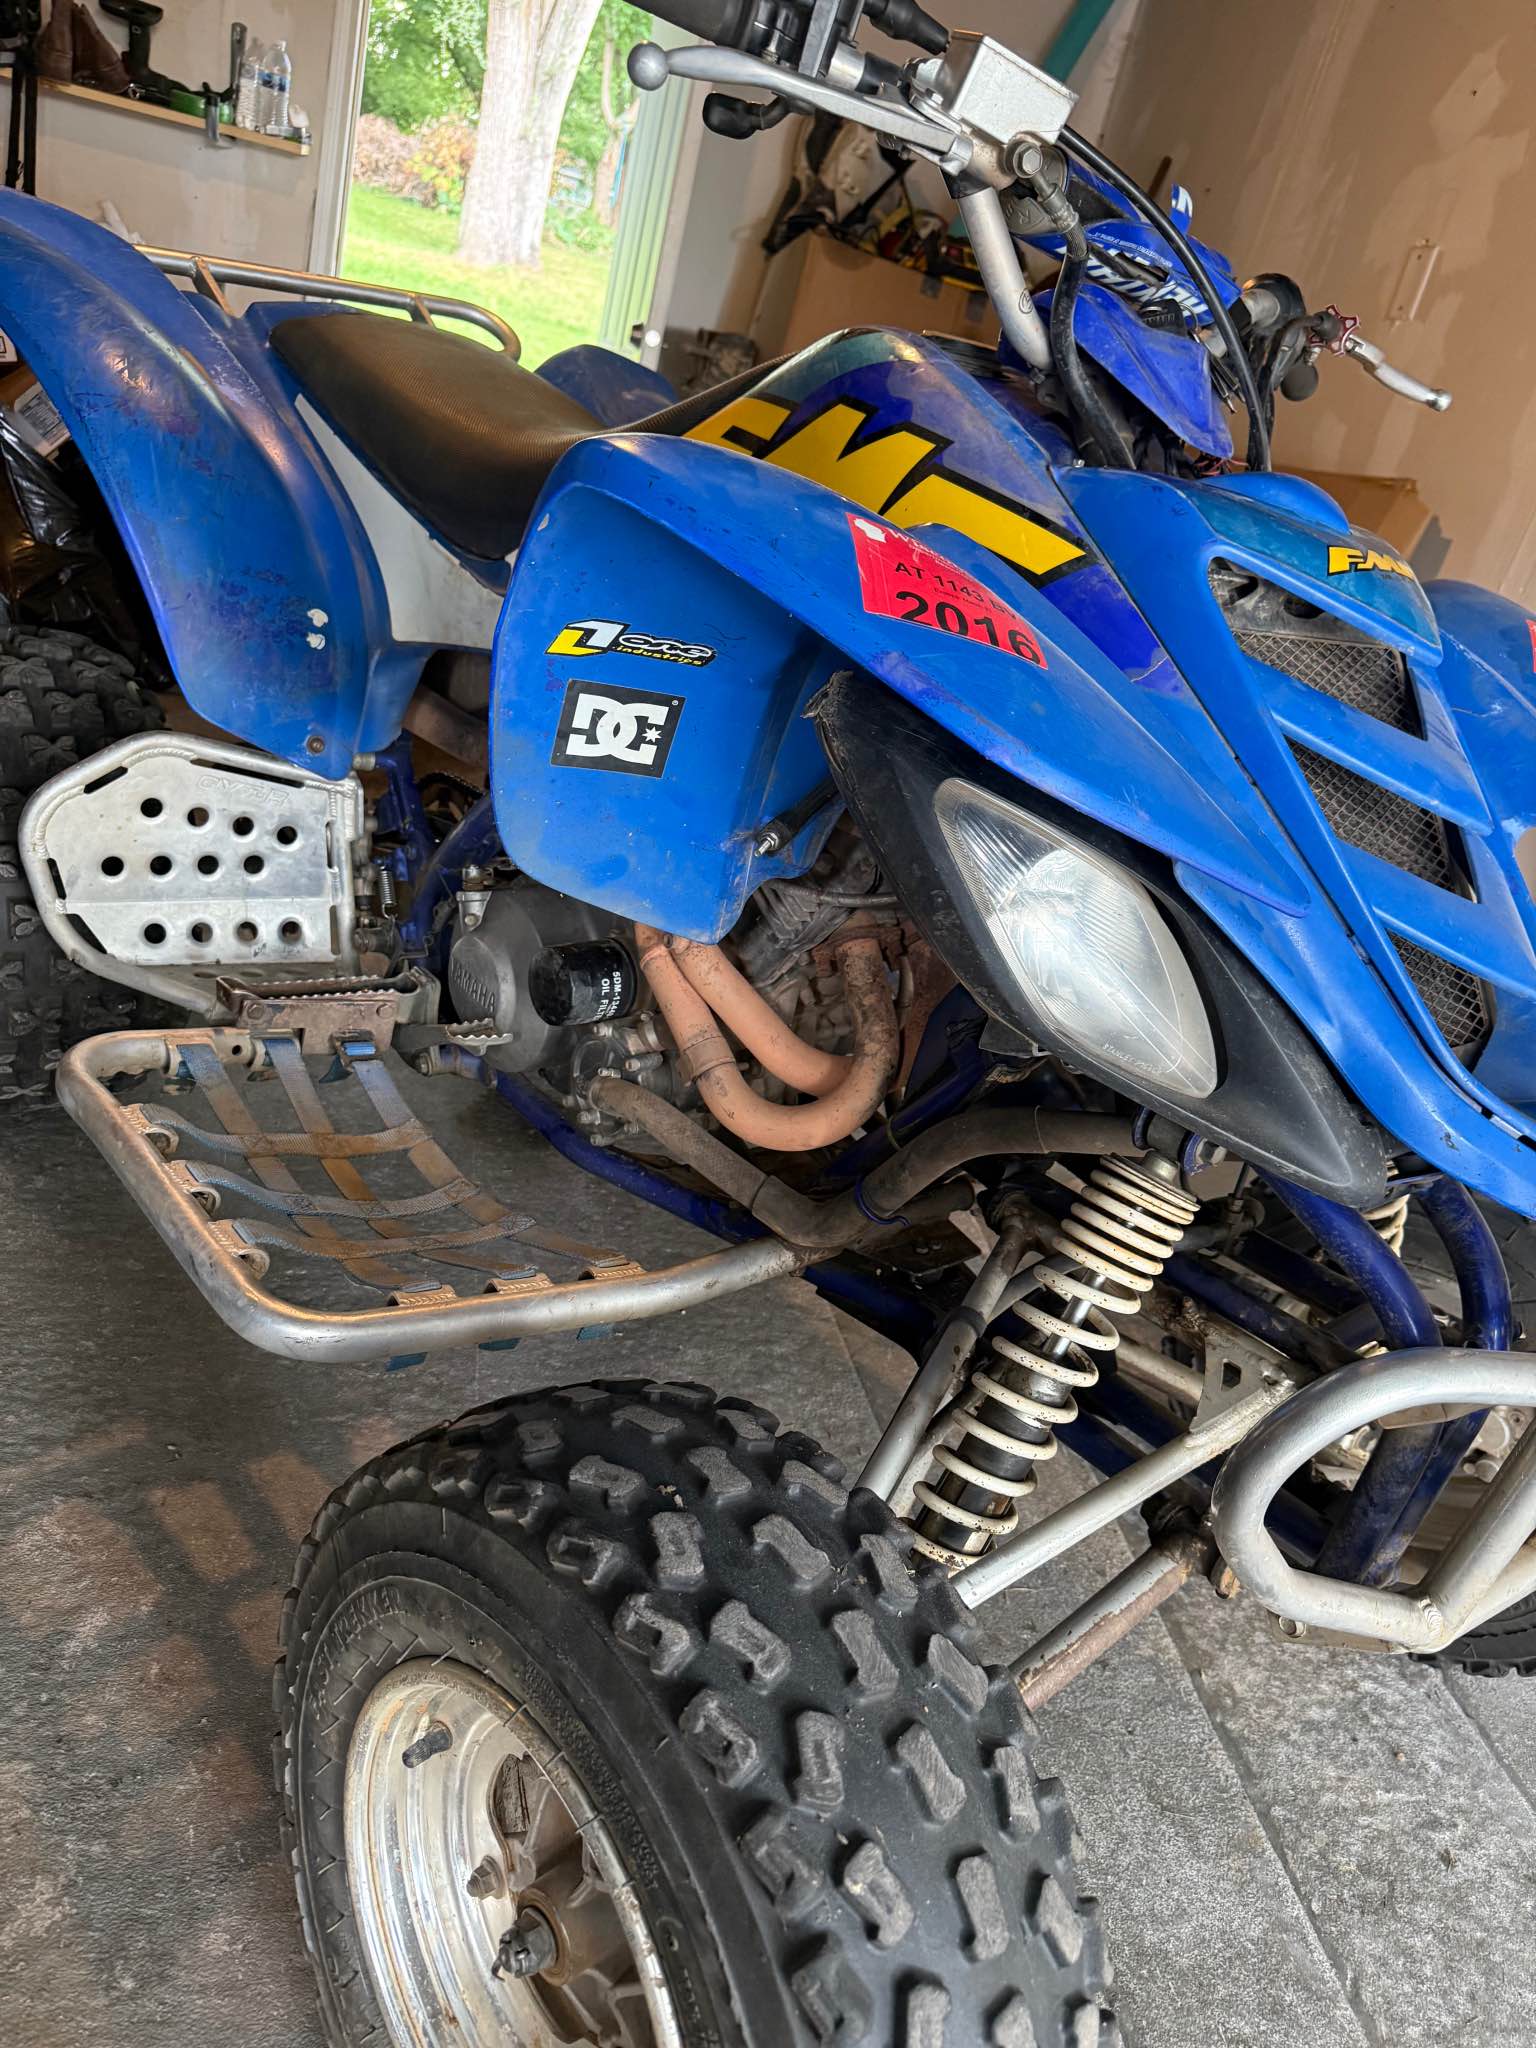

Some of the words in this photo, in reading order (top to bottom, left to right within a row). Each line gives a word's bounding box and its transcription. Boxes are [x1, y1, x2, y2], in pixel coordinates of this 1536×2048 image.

[895, 562, 924, 580] AT
[895, 591, 1042, 665] 2016
[565, 692, 670, 766] DC
[601, 977, 611, 996] OIL
[591, 999, 610, 1021] FILT
